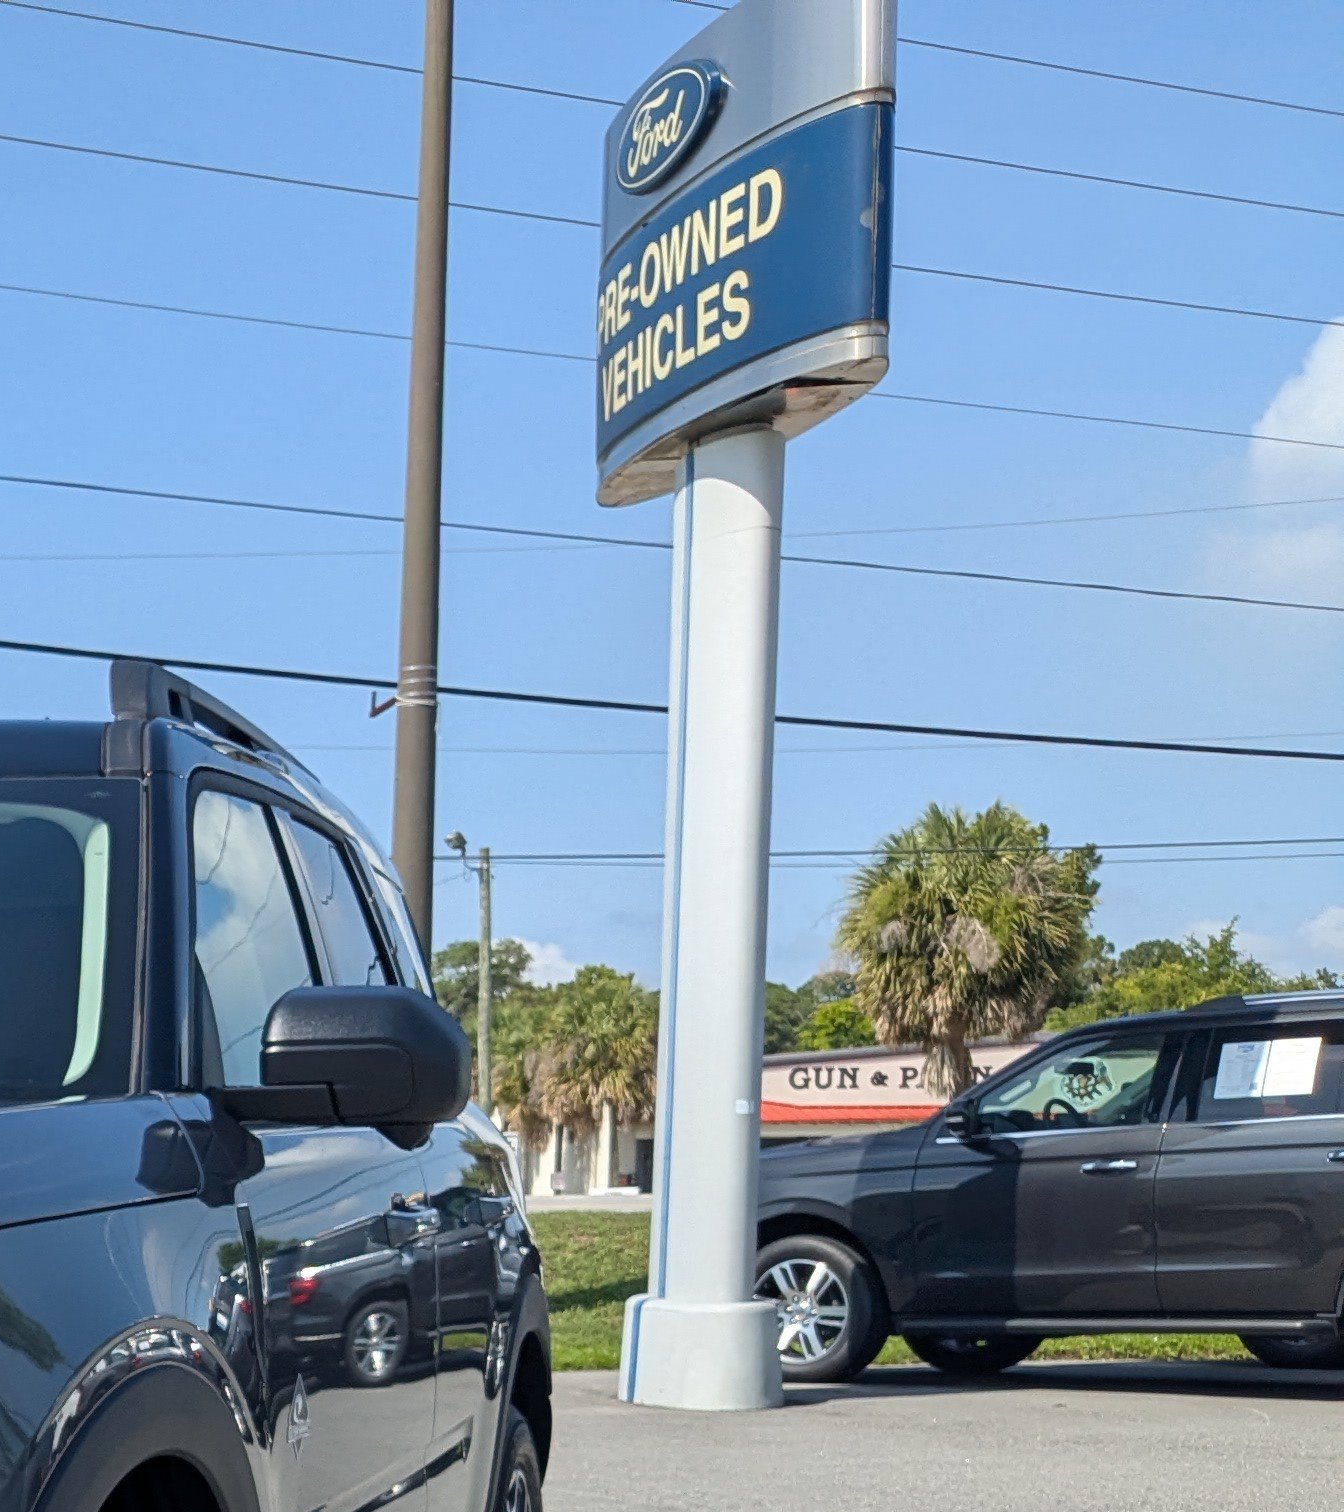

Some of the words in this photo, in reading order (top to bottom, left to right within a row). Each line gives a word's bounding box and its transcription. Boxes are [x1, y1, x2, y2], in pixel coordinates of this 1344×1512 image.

[628, 88, 685, 177] Ford
[603, 270, 750, 421] VEHICLES
[788, 1066, 859, 1090] GUN
[870, 1070, 889, 1087] &
